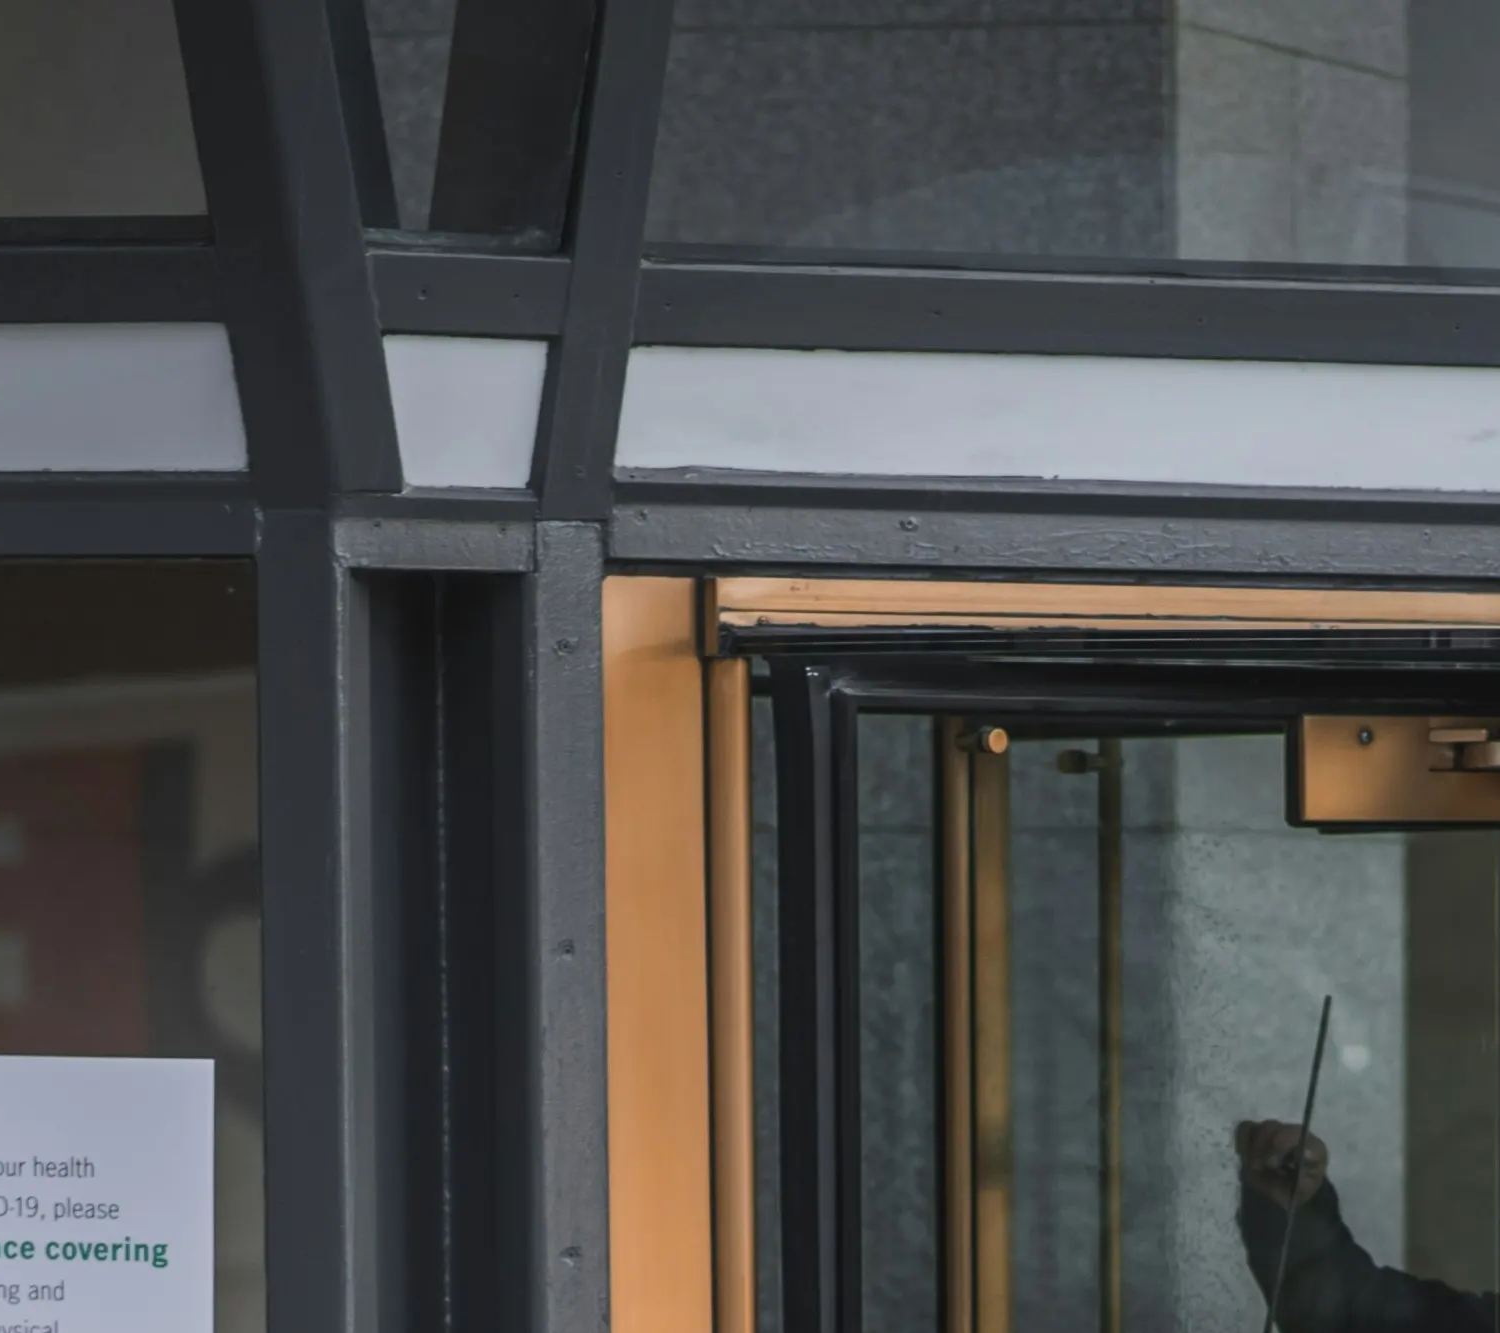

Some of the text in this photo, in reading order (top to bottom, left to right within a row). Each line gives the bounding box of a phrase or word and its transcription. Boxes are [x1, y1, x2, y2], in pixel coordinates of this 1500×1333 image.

[33, 1156, 95, 1178] health
[54, 1197, 119, 1221] please
[45, 1236, 168, 1268] covering
[28, 1280, 64, 1301] and
